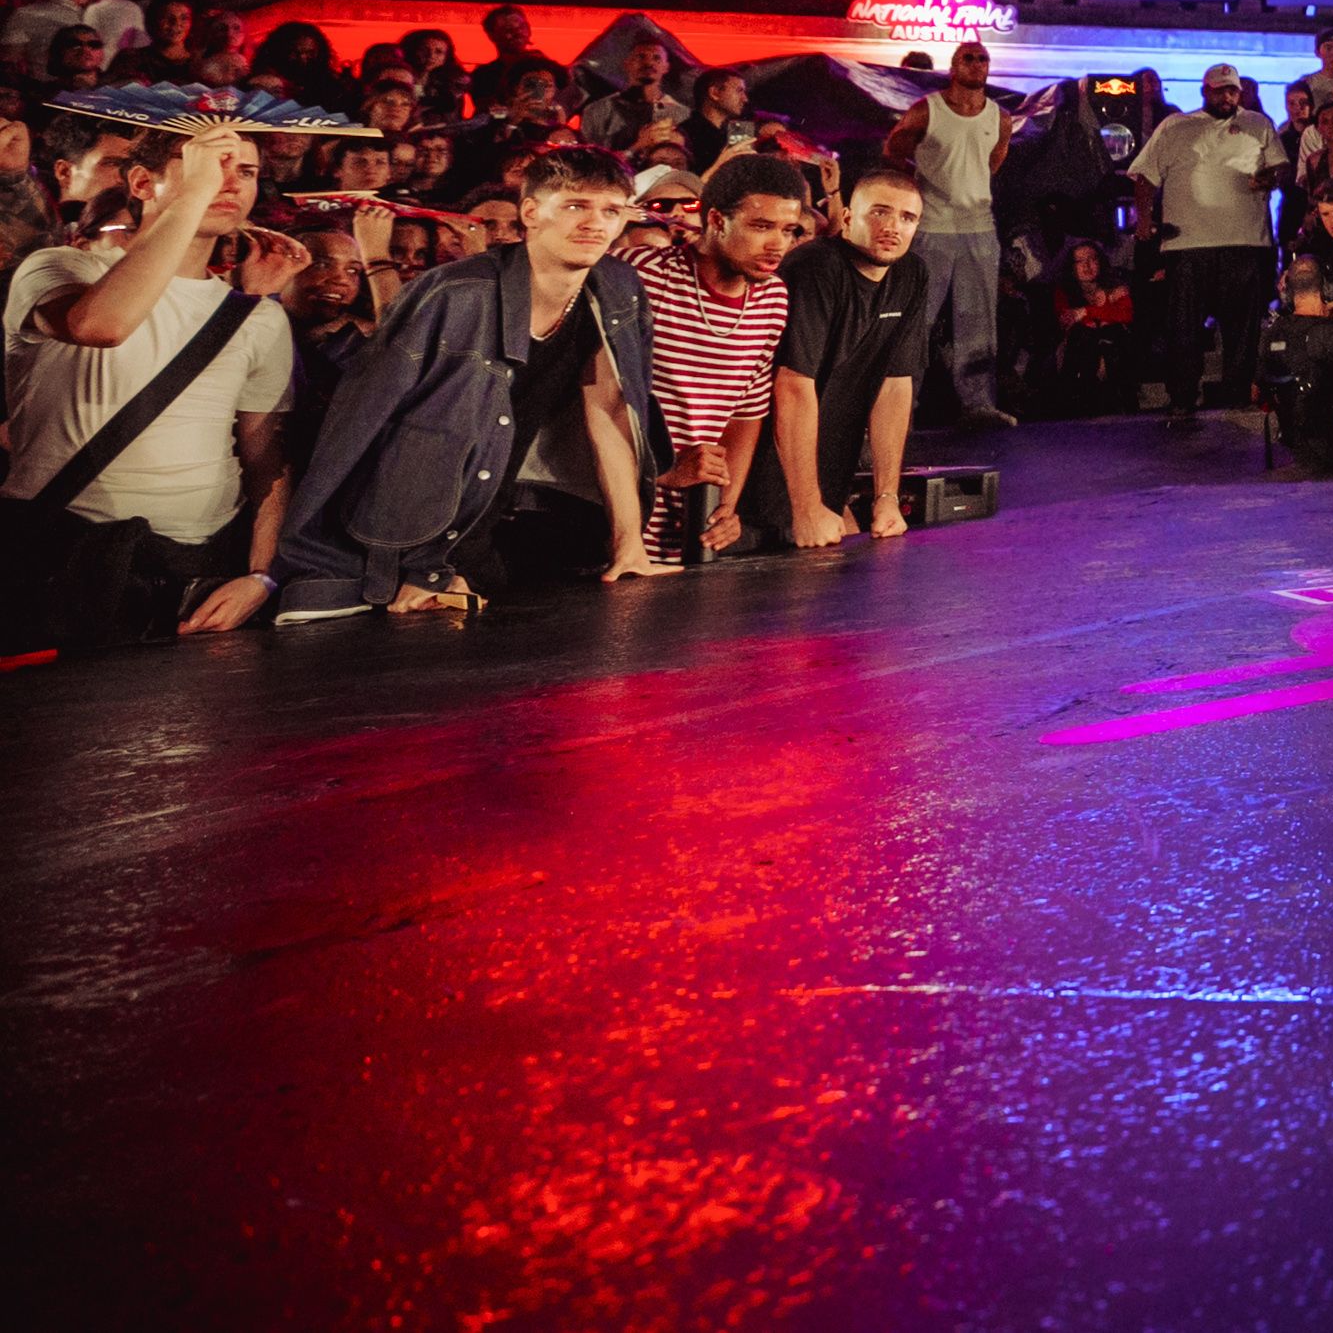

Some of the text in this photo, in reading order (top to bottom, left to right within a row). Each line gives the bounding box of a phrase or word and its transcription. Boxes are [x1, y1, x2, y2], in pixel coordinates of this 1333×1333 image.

[952, 1, 1014, 28] FINAL
[891, 25, 979, 42] AUSTRIA
[106, 108, 150, 121] vivo
